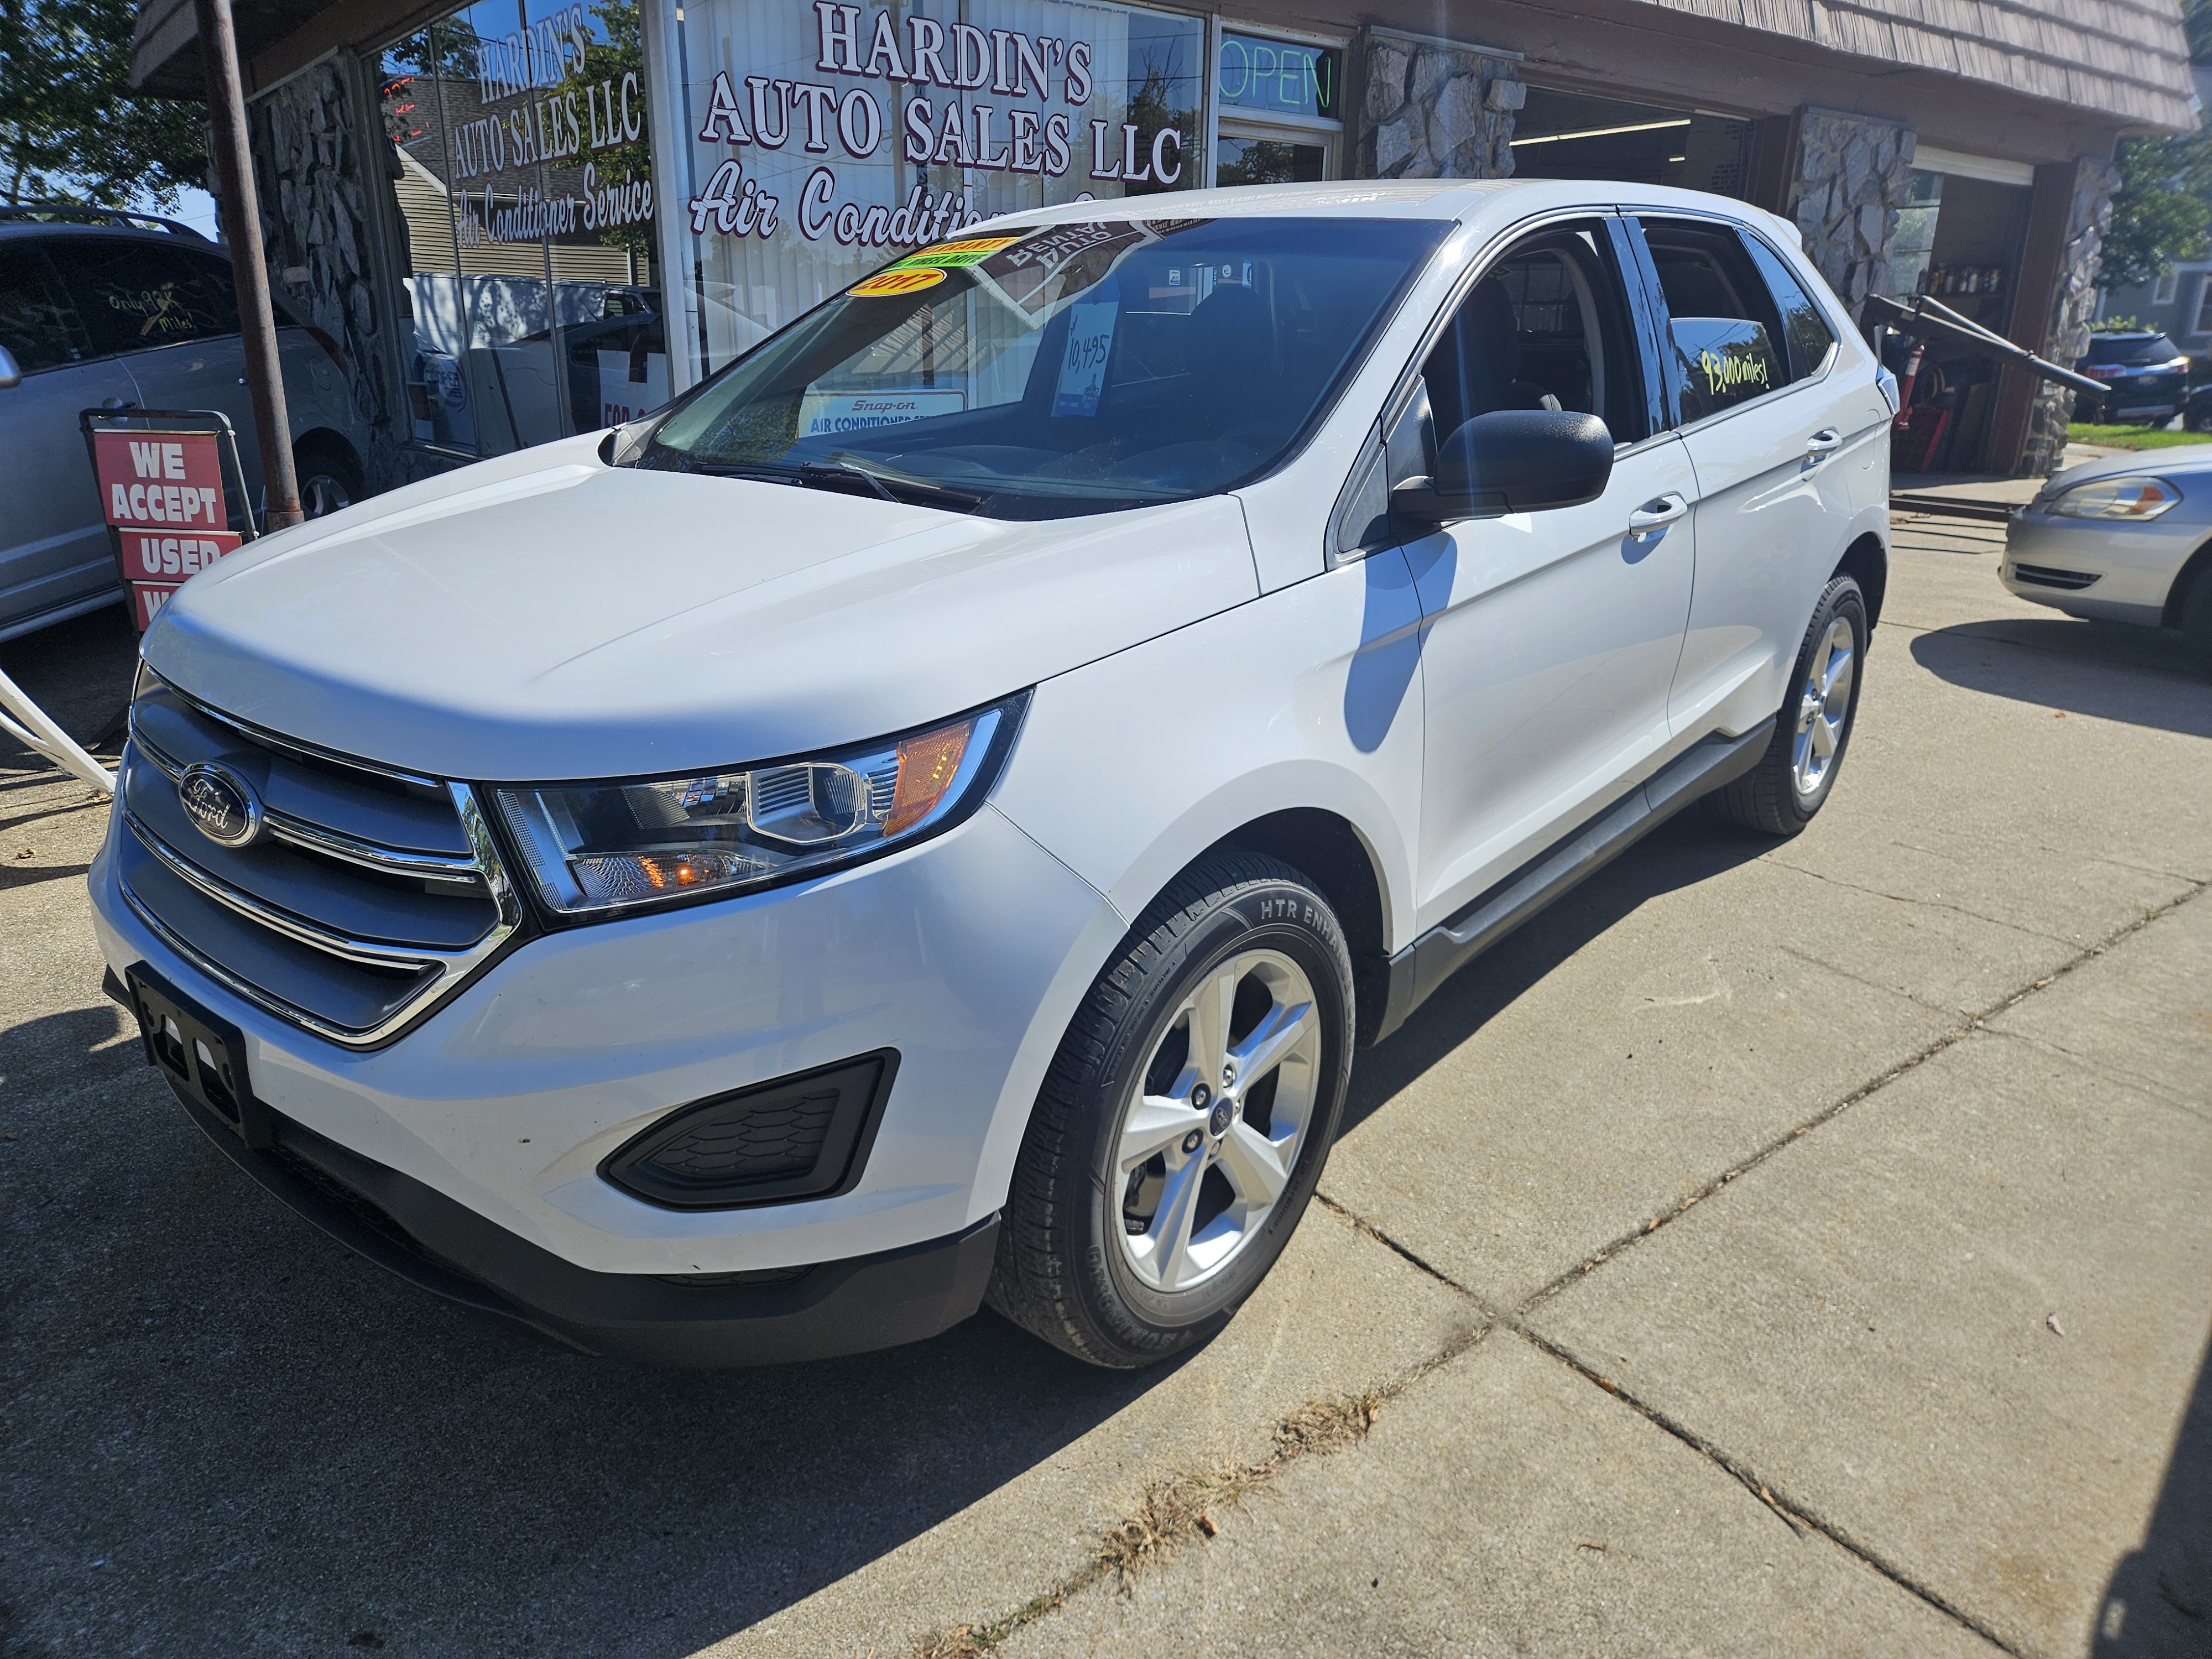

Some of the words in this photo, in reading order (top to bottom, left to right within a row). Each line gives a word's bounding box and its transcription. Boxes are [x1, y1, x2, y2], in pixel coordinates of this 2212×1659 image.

[477, 3, 586, 105] HARDIN'S
[813, 1, 1092, 106] HARDIN'S
[1219, 40, 1331, 107] OPEN
[455, 114, 505, 179] AUTO
[510, 92, 580, 167] SALES
[586, 71, 641, 149] LLC
[698, 71, 881, 159] AUTO
[905, 97, 1071, 178] SALES
[1089, 120, 1181, 185] LLC
[457, 189, 480, 248] Air
[484, 183, 576, 244] Conditioner
[583, 161, 654, 231] Service
[688, 159, 779, 239] Air
[851, 274, 941, 291] 2017
[1068, 333, 1109, 374] 10,495
[1702, 350, 1741, 395] 93,000
[1742, 352, 1770, 389] miles!
[811, 419, 831, 432] AIR
[852, 400, 916, 413] Snap-on
[129, 441, 186, 480] WE
[112, 483, 217, 524] ACCEPT
[140, 538, 221, 575] USED
[190, 779, 231, 830] Ford
[1261, 899, 1297, 919] HTR
